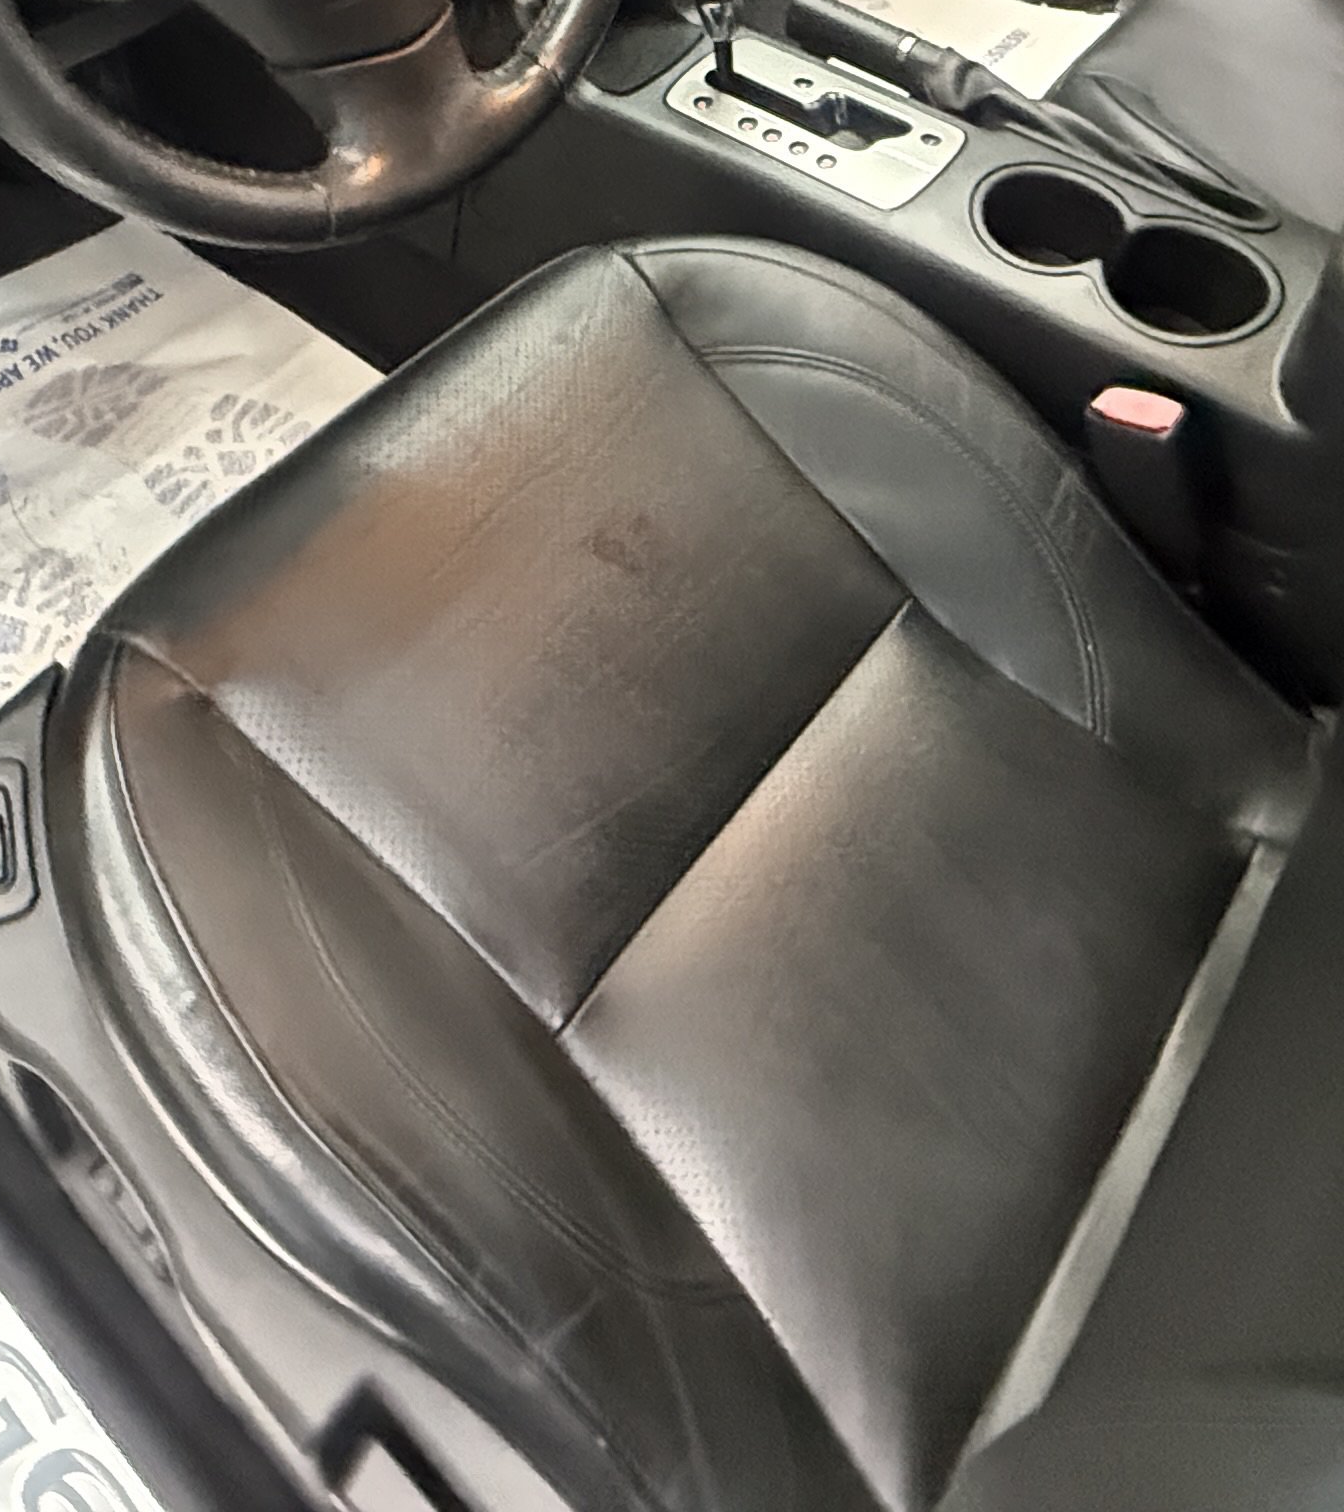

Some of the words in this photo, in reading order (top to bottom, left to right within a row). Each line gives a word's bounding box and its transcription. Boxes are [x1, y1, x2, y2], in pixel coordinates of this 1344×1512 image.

[99, 286, 164, 330] THANK
[51, 322, 101, 351] YOU,
[22, 344, 61, 373] WE
